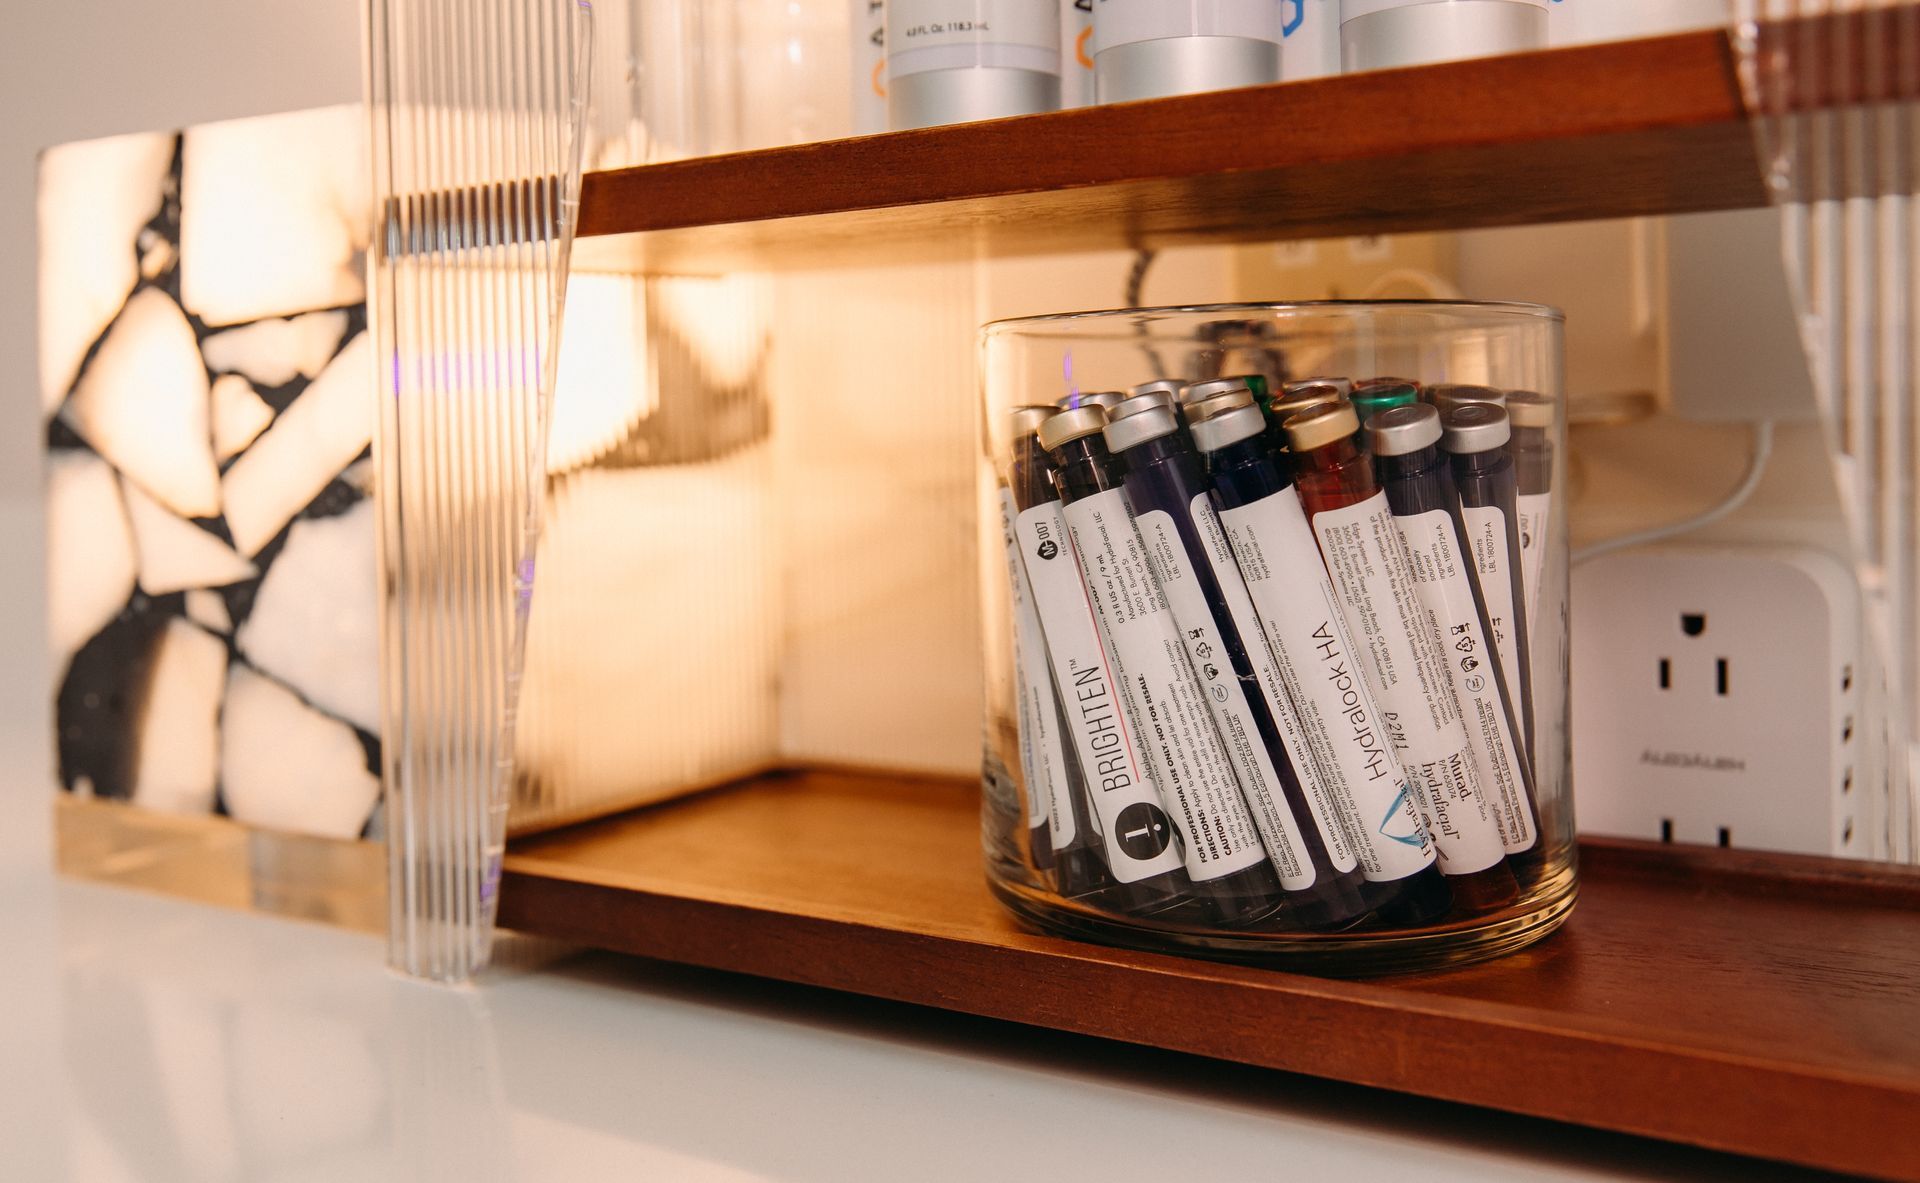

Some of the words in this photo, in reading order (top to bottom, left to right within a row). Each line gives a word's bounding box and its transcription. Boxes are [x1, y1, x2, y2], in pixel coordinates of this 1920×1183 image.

[1053, 517, 1068, 556] TECHNOLOGY
[1155, 523, 1174, 563] 1800724-A
[1342, 525, 1353, 544] 3600
[1436, 524, 1451, 562] 1800724-A
[1126, 539, 1139, 561] 90815
[1244, 542, 1253, 558] USA
[1246, 525, 1271, 579] hydrafacial.com
[1351, 522, 1360, 540] Edge
[1357, 540, 1368, 565] Systems
[1365, 565, 1375, 577] LLC
[1096, 554, 1104, 564] mL
[1134, 560, 1143, 573] CA
[1350, 553, 1362, 575] Burnett
[1413, 550, 1426, 575] globally
[1125, 566, 1137, 588] Burnett
[1172, 564, 1182, 579] LBL
[1250, 558, 1263, 581] 90815
[1423, 555, 1436, 582] sourced
[1447, 563, 1456, 577] LBL
[1108, 591, 1118, 603] US
[1115, 575, 1136, 620] Manufactured
[1149, 597, 1158, 613] Long
[1364, 596, 1373, 612] Long
[1135, 597, 1147, 616] 3600
[1331, 527, 1344, 545] (800)
[1339, 546, 1354, 580] 603-4996
[1351, 586, 1362, 603] (562)
[1357, 605, 1372, 635] 597-0102
[1369, 642, 1388, 690] hydrafacial.com
[1374, 536, 1389, 562] product
[1385, 563, 1394, 578] with
[1393, 590, 1401, 604] skin
[1397, 604, 1407, 620] must
[1409, 638, 1421, 661] limited
[1416, 661, 1430, 694] frequency
[1115, 610, 1125, 624] 0.3
[1369, 612, 1381, 635] Beach,
[1312, 621, 1340, 661] HA
[1377, 636, 1386, 647] CA
[1163, 639, 1176, 662] contact
[1381, 647, 1393, 669] 90815
[1170, 663, 1182, 682] Avoid
[1263, 664, 1279, 698] RESALE.
[1388, 670, 1398, 685] USA
[1138, 673, 1152, 704] RESALE.
[1148, 705, 1158, 722] FOR
[1186, 701, 1196, 720] empty
[1276, 699, 1287, 716] FOR
[1310, 699, 1319, 717] vials.
[1179, 713, 1187, 726] one
[1284, 718, 1294, 735] NOT
[1329, 661, 1387, 781] Hydralock
[1154, 724, 1165, 741] NOT
[1193, 722, 1202, 739] reuse
[1317, 718, 1329, 740] empty
[1171, 734, 1180, 746] and
[1185, 737, 1195, 749] vial
[1161, 742, 1174, 767] ONLY.
[1177, 748, 1185, 760] skin
[1192, 750, 1202, 767] entire
[1200, 748, 1210, 762] refill
[1326, 741, 1336, 761] reuse
[1182, 761, 1192, 779] clean
[1206, 763, 1214, 773] not
[1302, 761, 1312, 779] USE
[1409, 765, 1418, 778] P/N
[1439, 759, 1449, 774] P/N
[1170, 768, 1180, 784] USE
[1336, 769, 1346, 785] refill
[1448, 753, 1472, 802] Murad.
[1343, 784, 1351, 798] not
[1413, 780, 1428, 808] 2000021
[1443, 774, 1457, 799] 630174
[1190, 788, 1201, 807] Apply
[1206, 792, 1214, 803] not
[1349, 797, 1357, 810] Do
[1176, 785, 1201, 845] PROFESSIONAL
[1210, 804, 1218, 815] Do
[1310, 779, 1338, 842] PROFESSIONAL
[1198, 809, 1219, 860] DIRECTIONS:
[1214, 815, 1232, 856] CAUTION:
[1228, 824, 1237, 838] only
[1197, 846, 1207, 863] FOR
[1335, 842, 1345, 860] FOR
[1368, 848, 1378, 862] one
[1374, 862, 1382, 873] for
